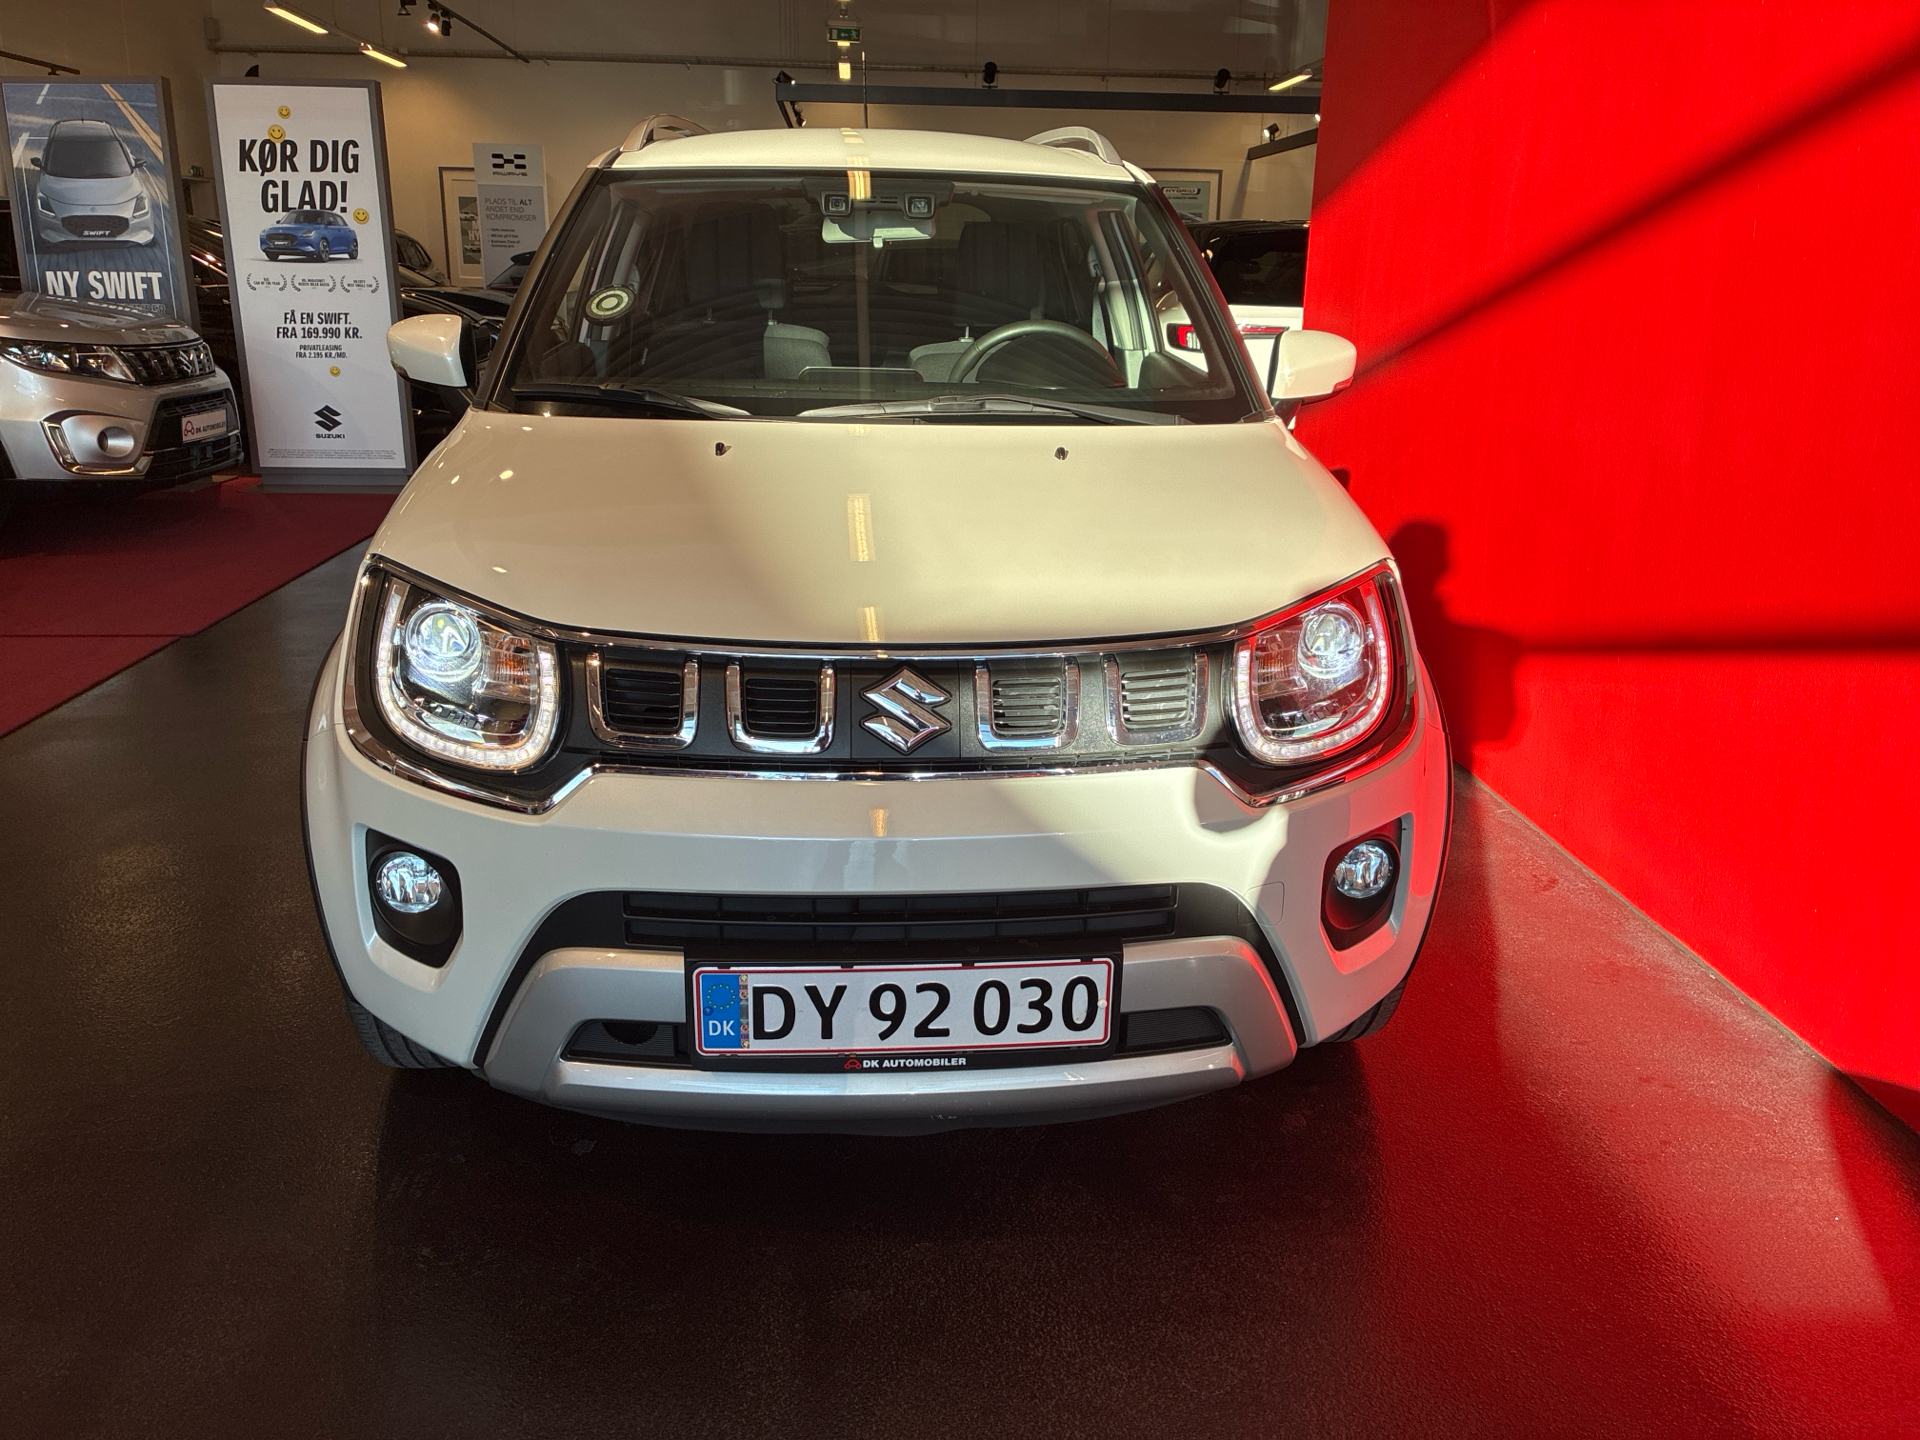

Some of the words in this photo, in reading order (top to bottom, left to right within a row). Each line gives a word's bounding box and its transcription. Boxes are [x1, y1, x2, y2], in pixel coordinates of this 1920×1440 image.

[238, 138, 299, 176] KØR
[309, 139, 359, 174] DIG
[261, 179, 348, 213] GLAD!
[484, 197, 507, 205] PLADS
[486, 213, 537, 222] KOMPROMISER
[45, 271, 80, 298] NY
[88, 271, 162, 300] SWIFT
[284, 309, 297, 325] FÅ
[300, 312, 314, 325] EN
[317, 312, 352, 325] SWIFT.
[276, 327, 298, 339] FRA
[301, 327, 341, 339] 169.990
[345, 327, 363, 339] KR.
[708, 1020, 735, 1036] DK
[752, 983, 848, 1040] DY
[868, 981, 951, 1041] 92
[973, 975, 1099, 1036] 030
[863, 1060, 880, 1068] DK
[883, 1058, 967, 1068] AUTOMOBILER
